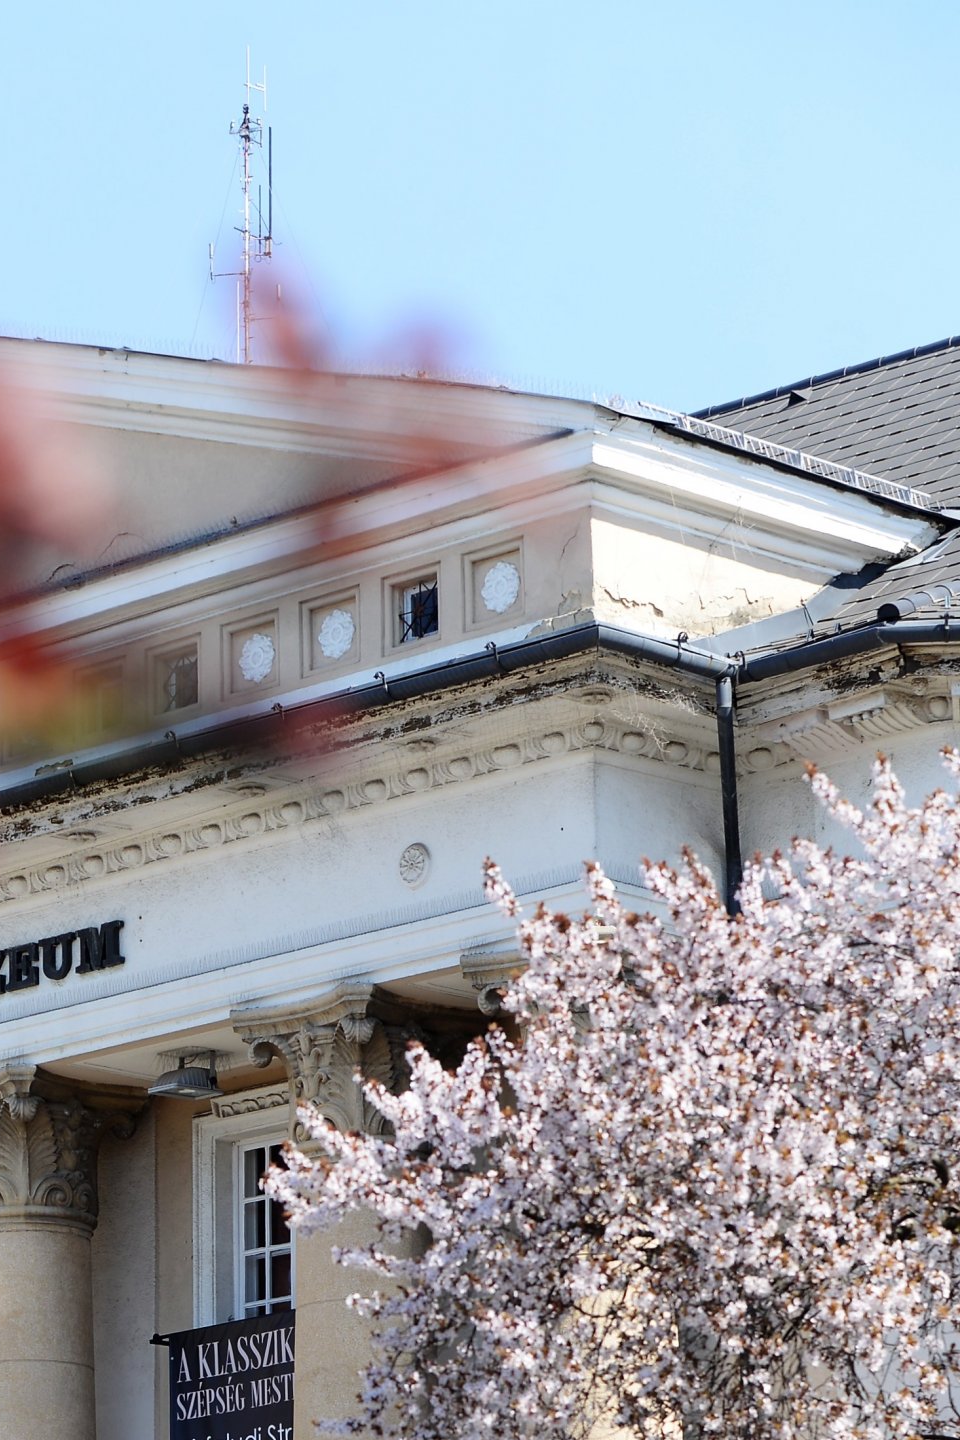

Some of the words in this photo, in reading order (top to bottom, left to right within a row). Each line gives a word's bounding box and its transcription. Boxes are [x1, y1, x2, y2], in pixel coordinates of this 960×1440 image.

[176, 1348, 192, 1384] A
[197, 1327, 295, 1380] KLASSZIK
[176, 1376, 245, 1421] SZÉPSÉG
